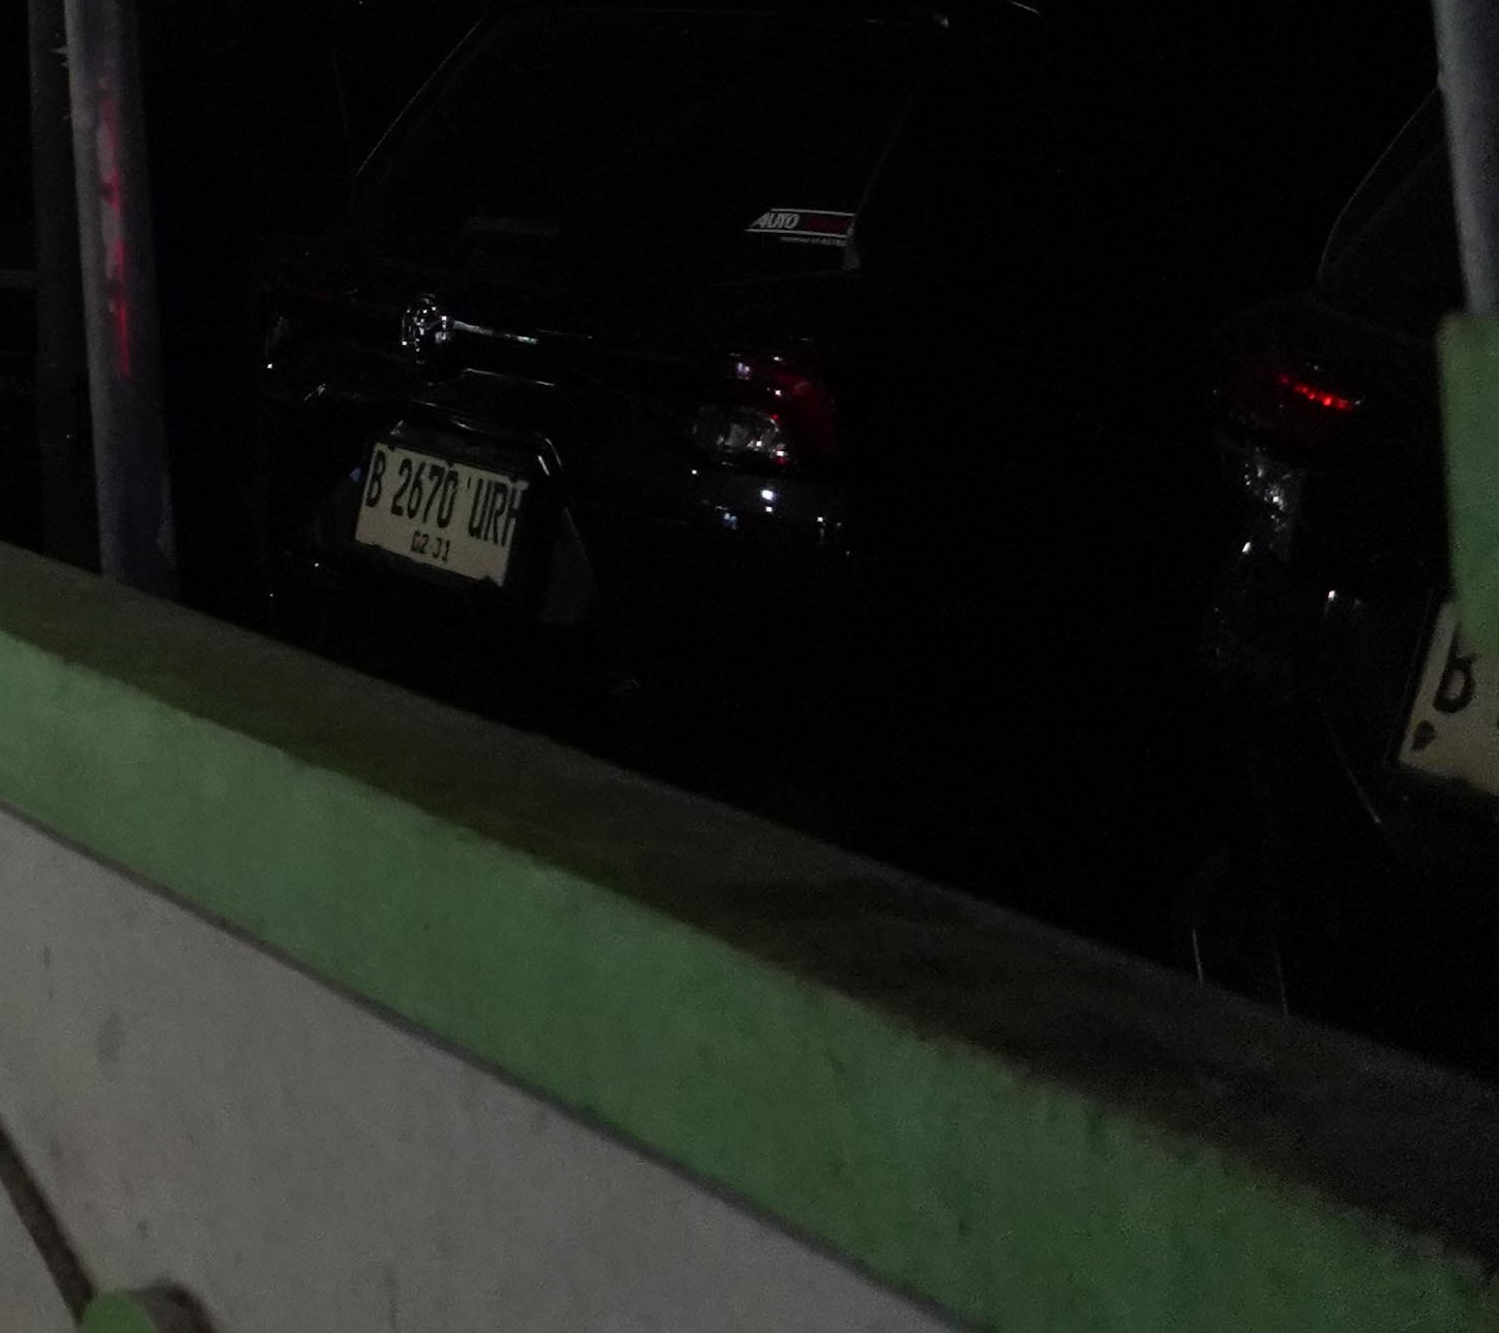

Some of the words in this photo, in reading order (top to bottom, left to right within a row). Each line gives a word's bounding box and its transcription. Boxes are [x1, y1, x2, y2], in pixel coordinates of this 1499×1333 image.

[749, 212, 801, 230] AUTO
[365, 450, 386, 508] B
[391, 458, 459, 528] 2670
